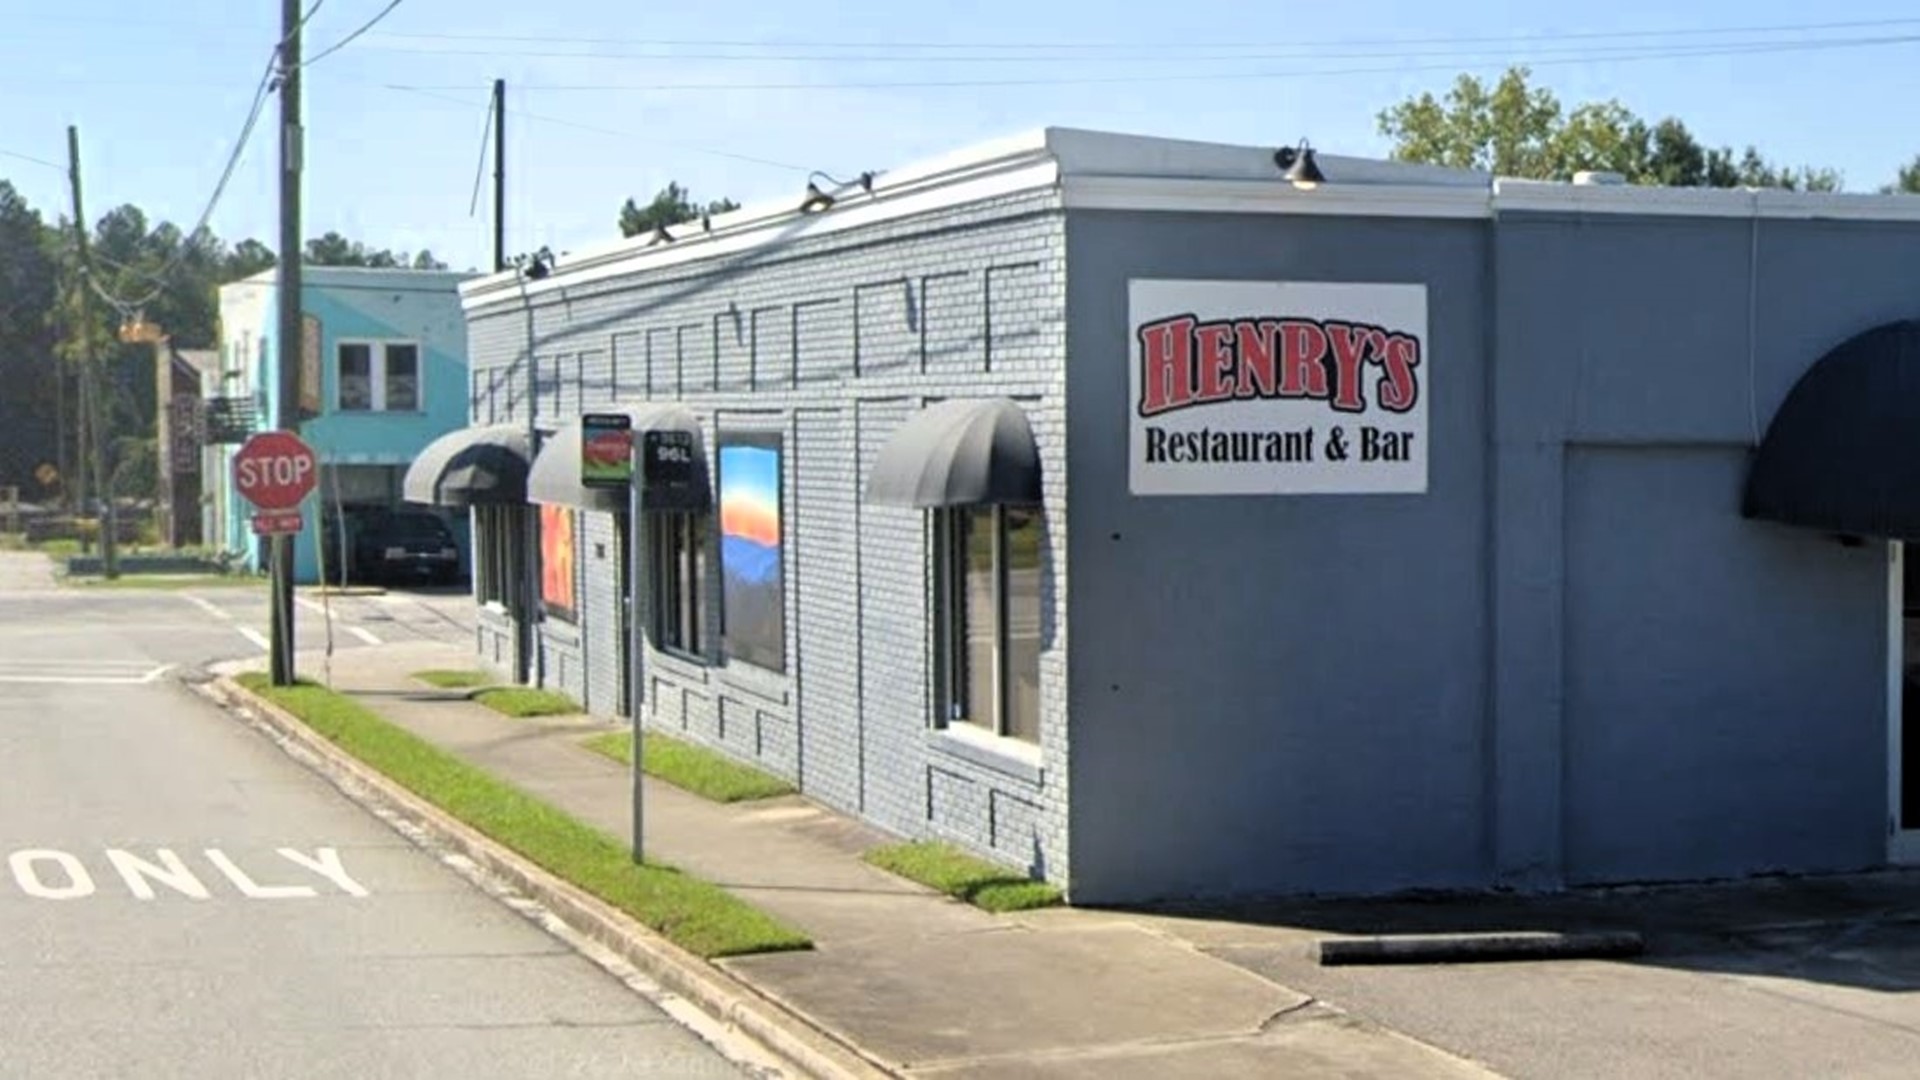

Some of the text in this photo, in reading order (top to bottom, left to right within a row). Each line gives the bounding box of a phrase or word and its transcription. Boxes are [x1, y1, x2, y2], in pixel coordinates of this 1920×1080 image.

[1138, 313, 1420, 418] HENRY'S
[1145, 426, 1414, 463] Restaurant & Bar
[240, 454, 312, 488] STOP
[8, 848, 369, 900] ONLY
